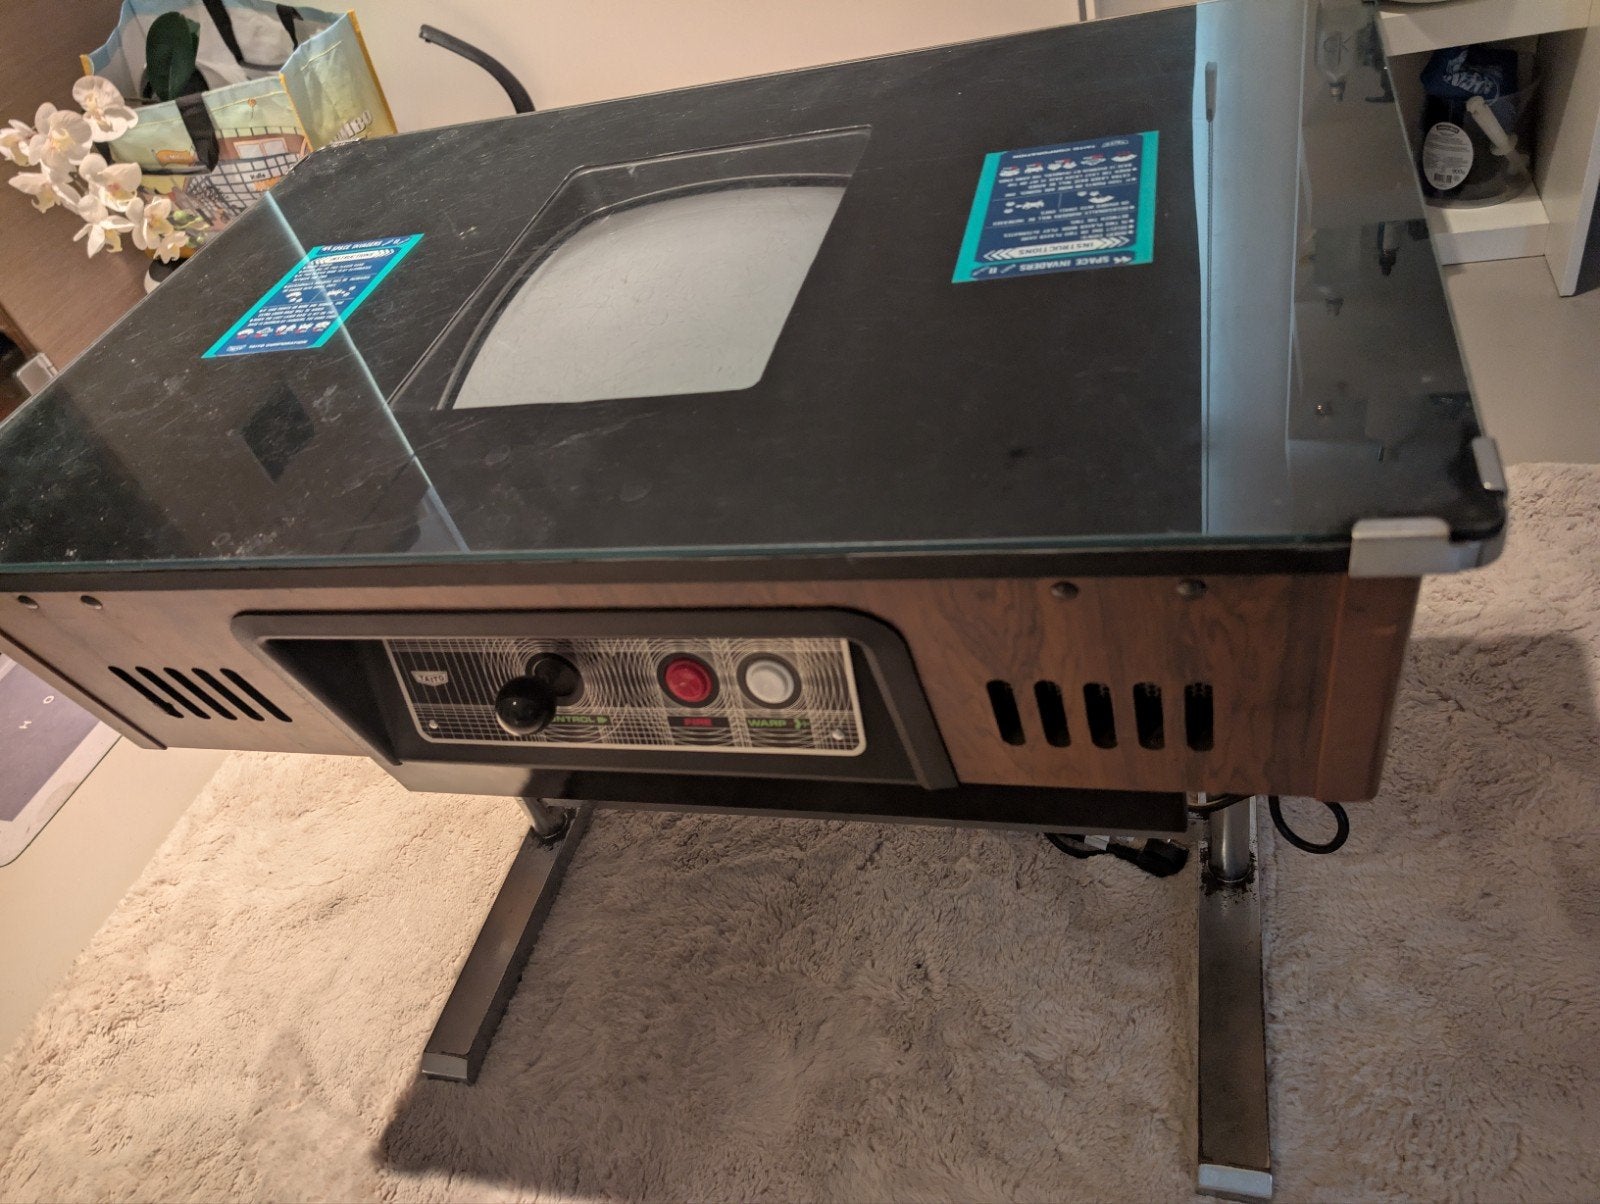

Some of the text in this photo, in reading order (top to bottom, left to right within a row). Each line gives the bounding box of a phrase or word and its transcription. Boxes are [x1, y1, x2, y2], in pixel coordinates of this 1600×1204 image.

[1017, 242, 1093, 255] INSTRUCTIONS
[1075, 255, 1109, 265] SPACE
[1019, 259, 1071, 271] INVADERS
[419, 674, 445, 683] TAITO
[552, 716, 595, 724] NTROL
[683, 718, 712, 726] FIRE
[747, 719, 786, 728] WARP
